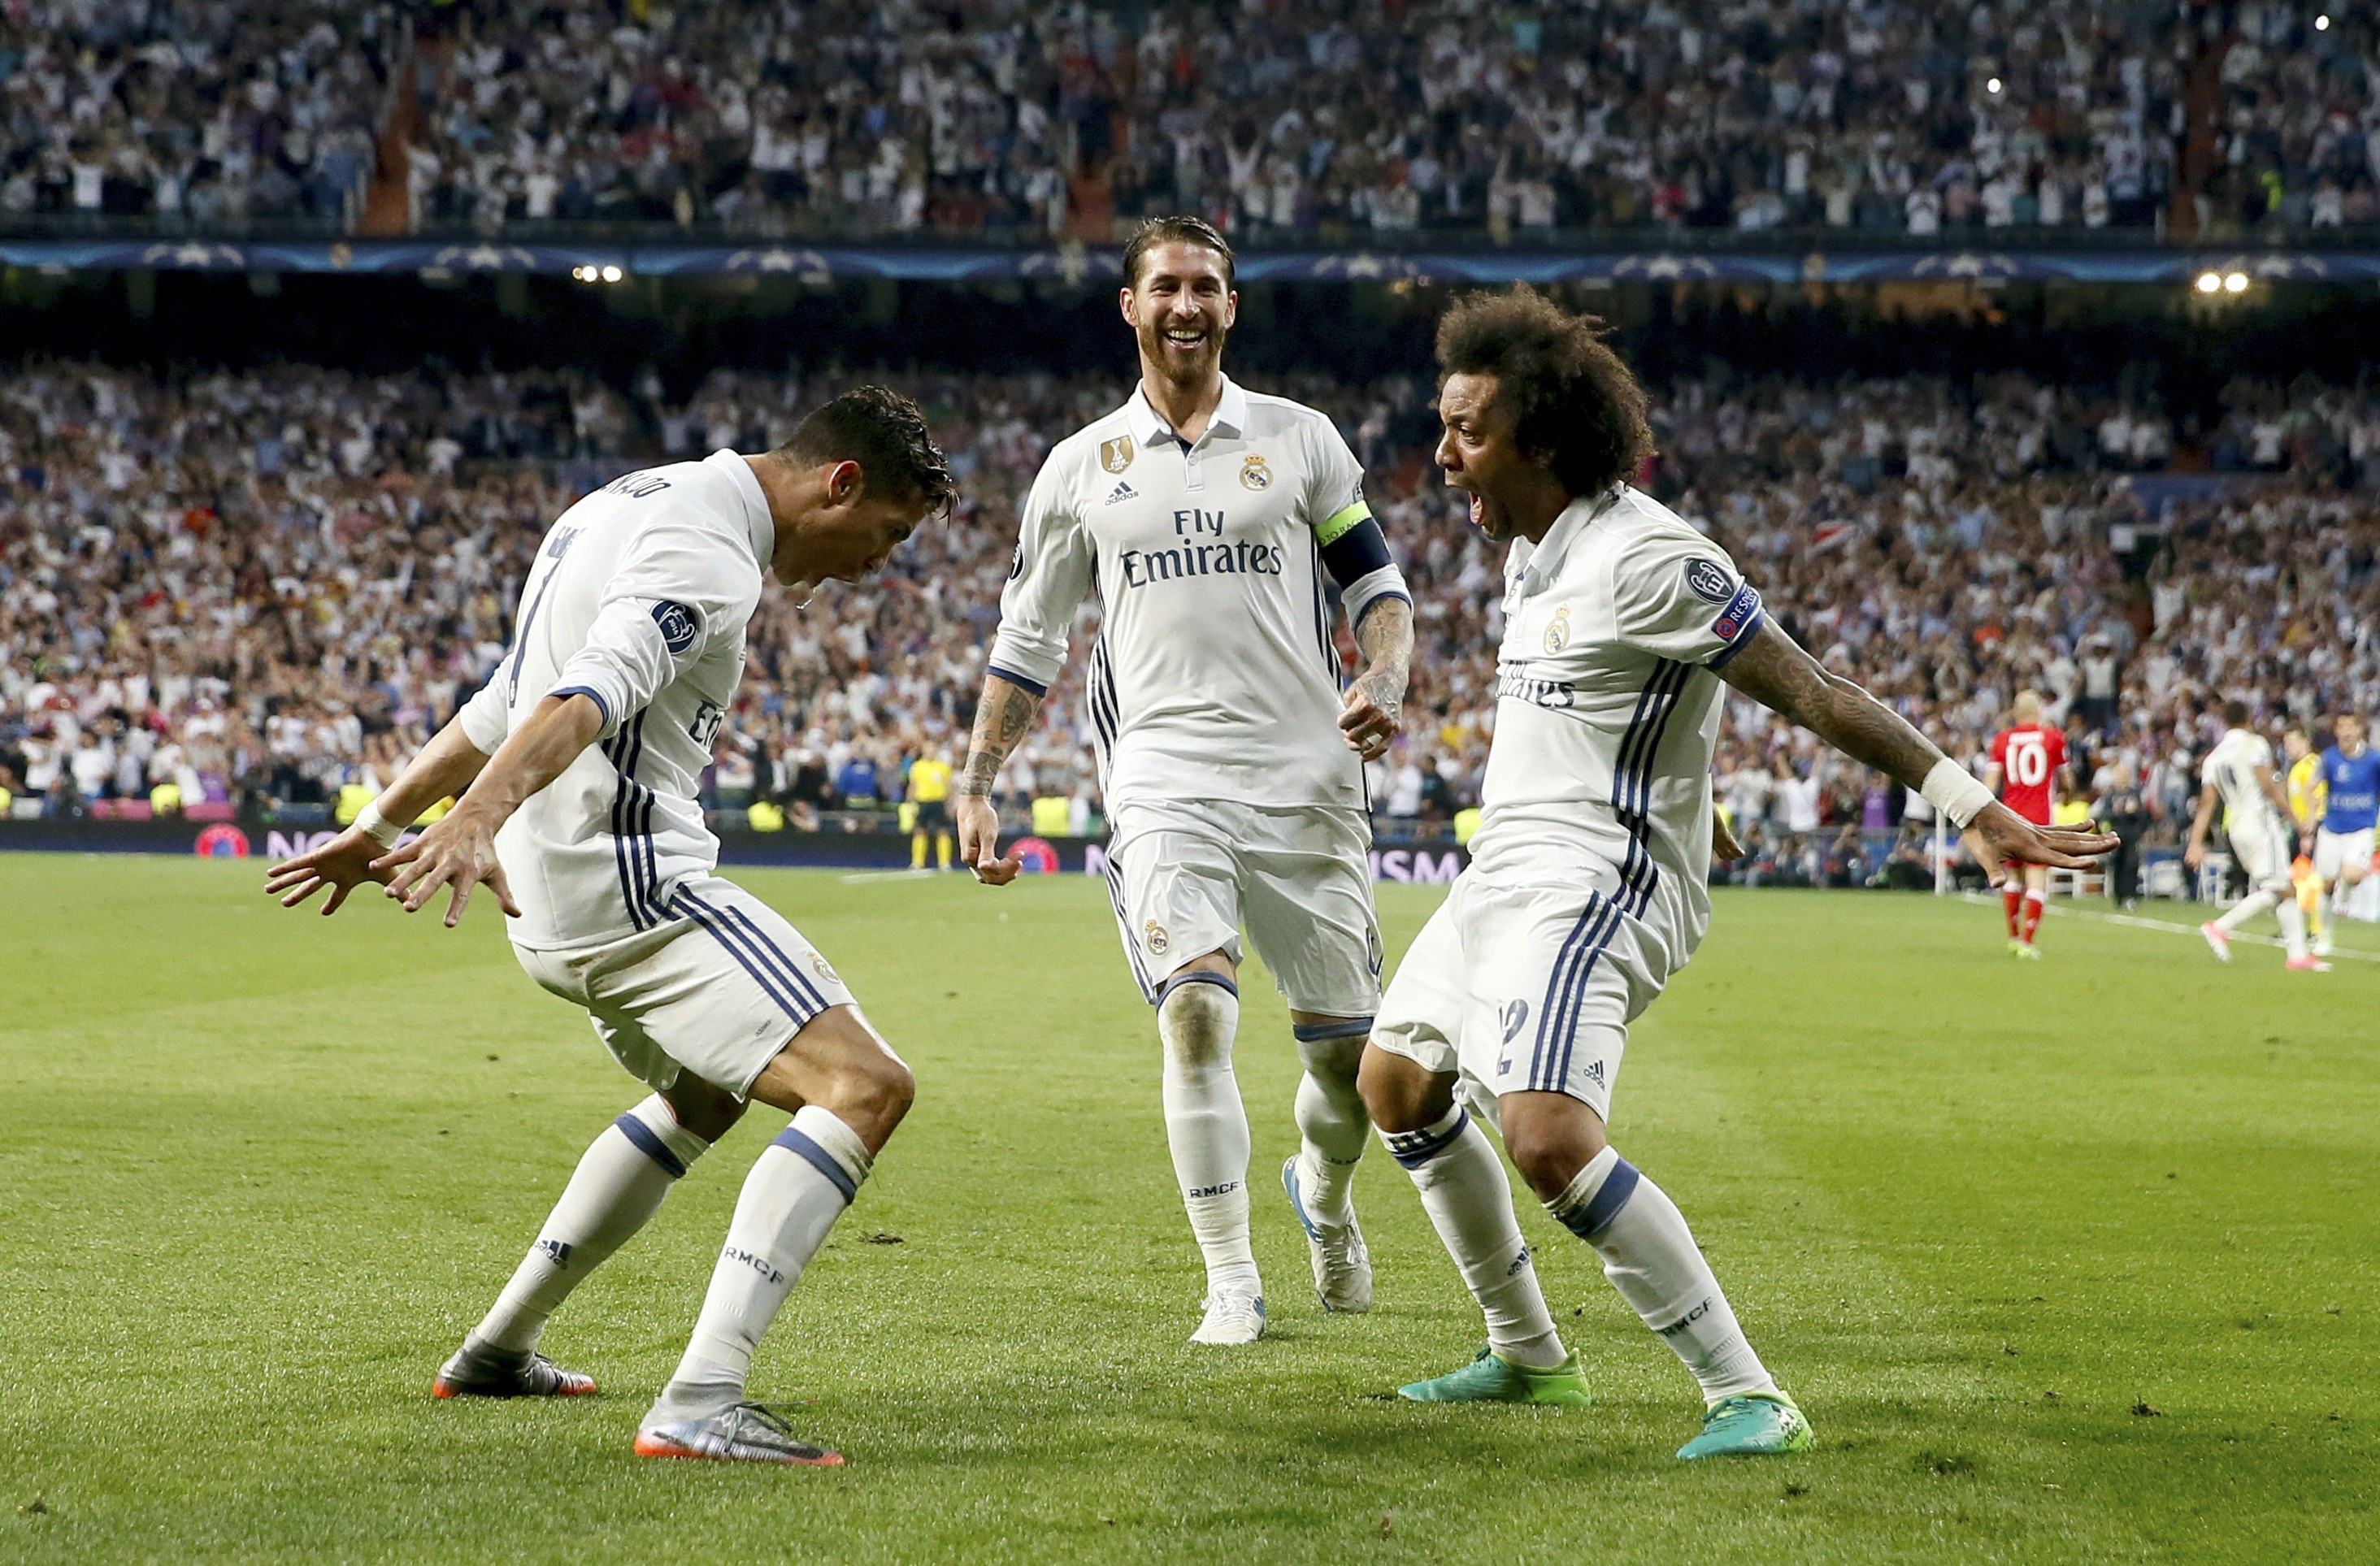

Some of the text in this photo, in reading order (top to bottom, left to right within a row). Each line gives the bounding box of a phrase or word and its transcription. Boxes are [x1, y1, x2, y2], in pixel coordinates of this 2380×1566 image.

[1105, 491, 1139, 505] adidas
[1173, 509, 1224, 536] Fly
[1121, 538, 1282, 588] Emirates
[2005, 742, 2048, 787] 10
[1189, 1182, 1239, 1198] RMCF
[724, 1247, 784, 1283] RMCF
[1660, 1295, 1712, 1338] RMCF
